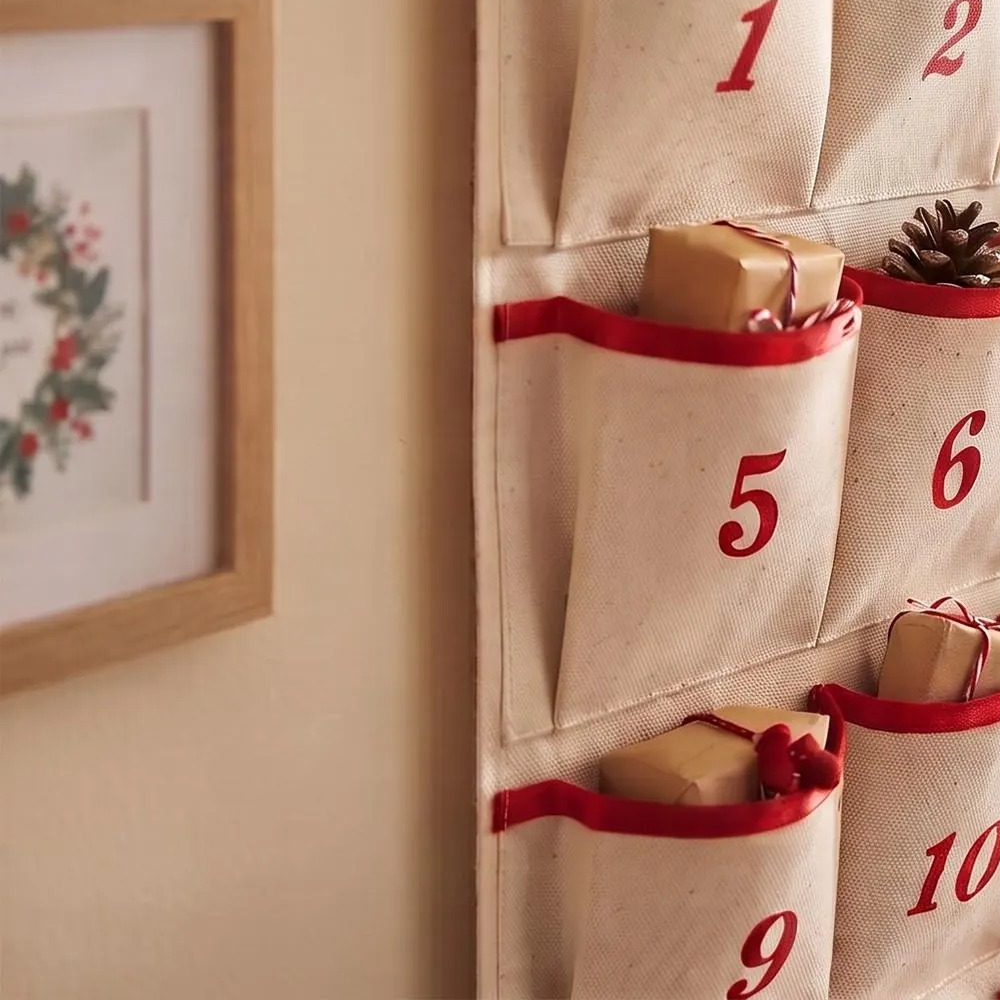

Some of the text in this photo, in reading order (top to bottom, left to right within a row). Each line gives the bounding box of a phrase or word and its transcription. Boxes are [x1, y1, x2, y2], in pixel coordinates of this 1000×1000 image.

[718, 449, 786, 558] 5
[931, 410, 987, 510] 6
[726, 910, 798, 1000] 9
